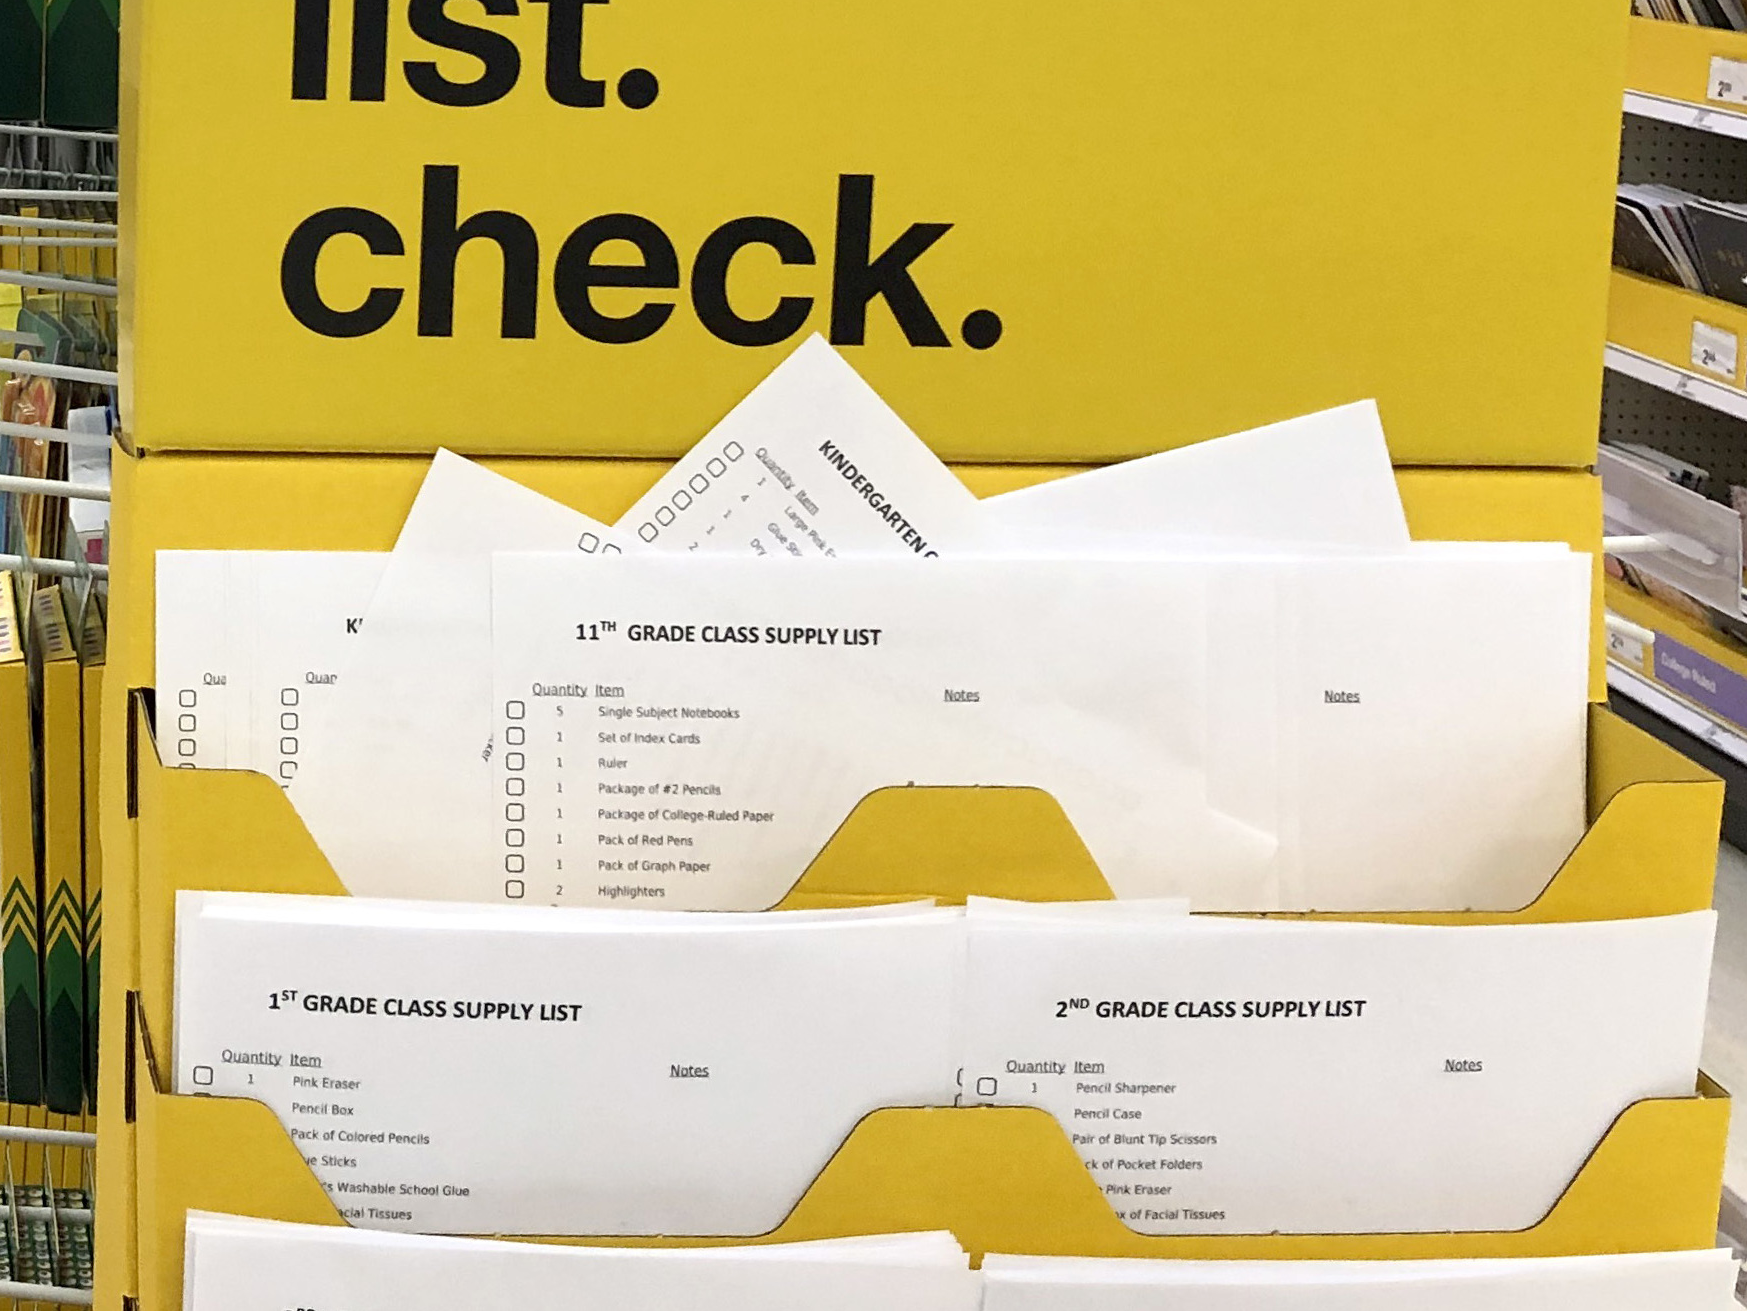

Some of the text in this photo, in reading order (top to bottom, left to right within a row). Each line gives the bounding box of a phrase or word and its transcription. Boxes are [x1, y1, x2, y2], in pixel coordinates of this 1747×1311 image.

[280, 164, 1004, 351] check.
[754, 447, 819, 517] Quantity Item
[818, 439, 927, 553] KINDERGARTEN
[784, 506, 809, 532] Large
[767, 522, 787, 545] Glue
[576, 621, 883, 646] 11TH GRADE CLASS SUPPLY LIST
[532, 683, 980, 703] Quantity Item Notes
[1324, 690, 1361, 704] Notes
[556, 705, 740, 720] 5 Single Subject Notebooks
[557, 731, 701, 744] 1 Set of Index Cards
[557, 757, 628, 769] 1 Ruler
[557, 782, 721, 797] 1 Package of #2 Pencils
[557, 808, 774, 823] 1 Package of College-Ruled Paper
[557, 834, 693, 846] 1 Pack of Red Pens
[557, 859, 711, 874] 1 Pack of Graph Paper
[556, 884, 665, 899] 2 Highlighters
[268, 990, 583, 1022] 1ST GRADE CLASS SUPPLY LIST
[1055, 998, 1367, 1019] 2ND GRADE CLASS SUPPLY LIST
[221, 1049, 709, 1079] Quantity Item Notes
[1005, 1059, 1483, 1075] Quantity Item Notes
[248, 1074, 361, 1090] 1 Pink Eraser
[1032, 1082, 1177, 1096] 1 Pencil Sharpener
[292, 1102, 354, 1116] Pencil Box
[1074, 1108, 1142, 1119] Pencil Case
[291, 1128, 430, 1145] Pack of Colored Pencils
[1072, 1133, 1217, 1147] Pair of Blunt Tip Scissors
[321, 1155, 357, 1167] Sticks
[1102, 1158, 1114, 1170] of
[1117, 1159, 1157, 1170] Pocket
[1160, 1159, 1203, 1170] Folders
[337, 1182, 396, 1195] Washable
[399, 1184, 439, 1196] School
[442, 1185, 470, 1197] Glue
[1105, 1184, 1130, 1195] Pink
[1134, 1184, 1172, 1195] Eraser
[338, 1207, 412, 1220] acial Tissues
[1129, 1209, 1142, 1220] of
[1145, 1209, 1179, 1220] Facial
[1182, 1209, 1226, 1220] Tissues
